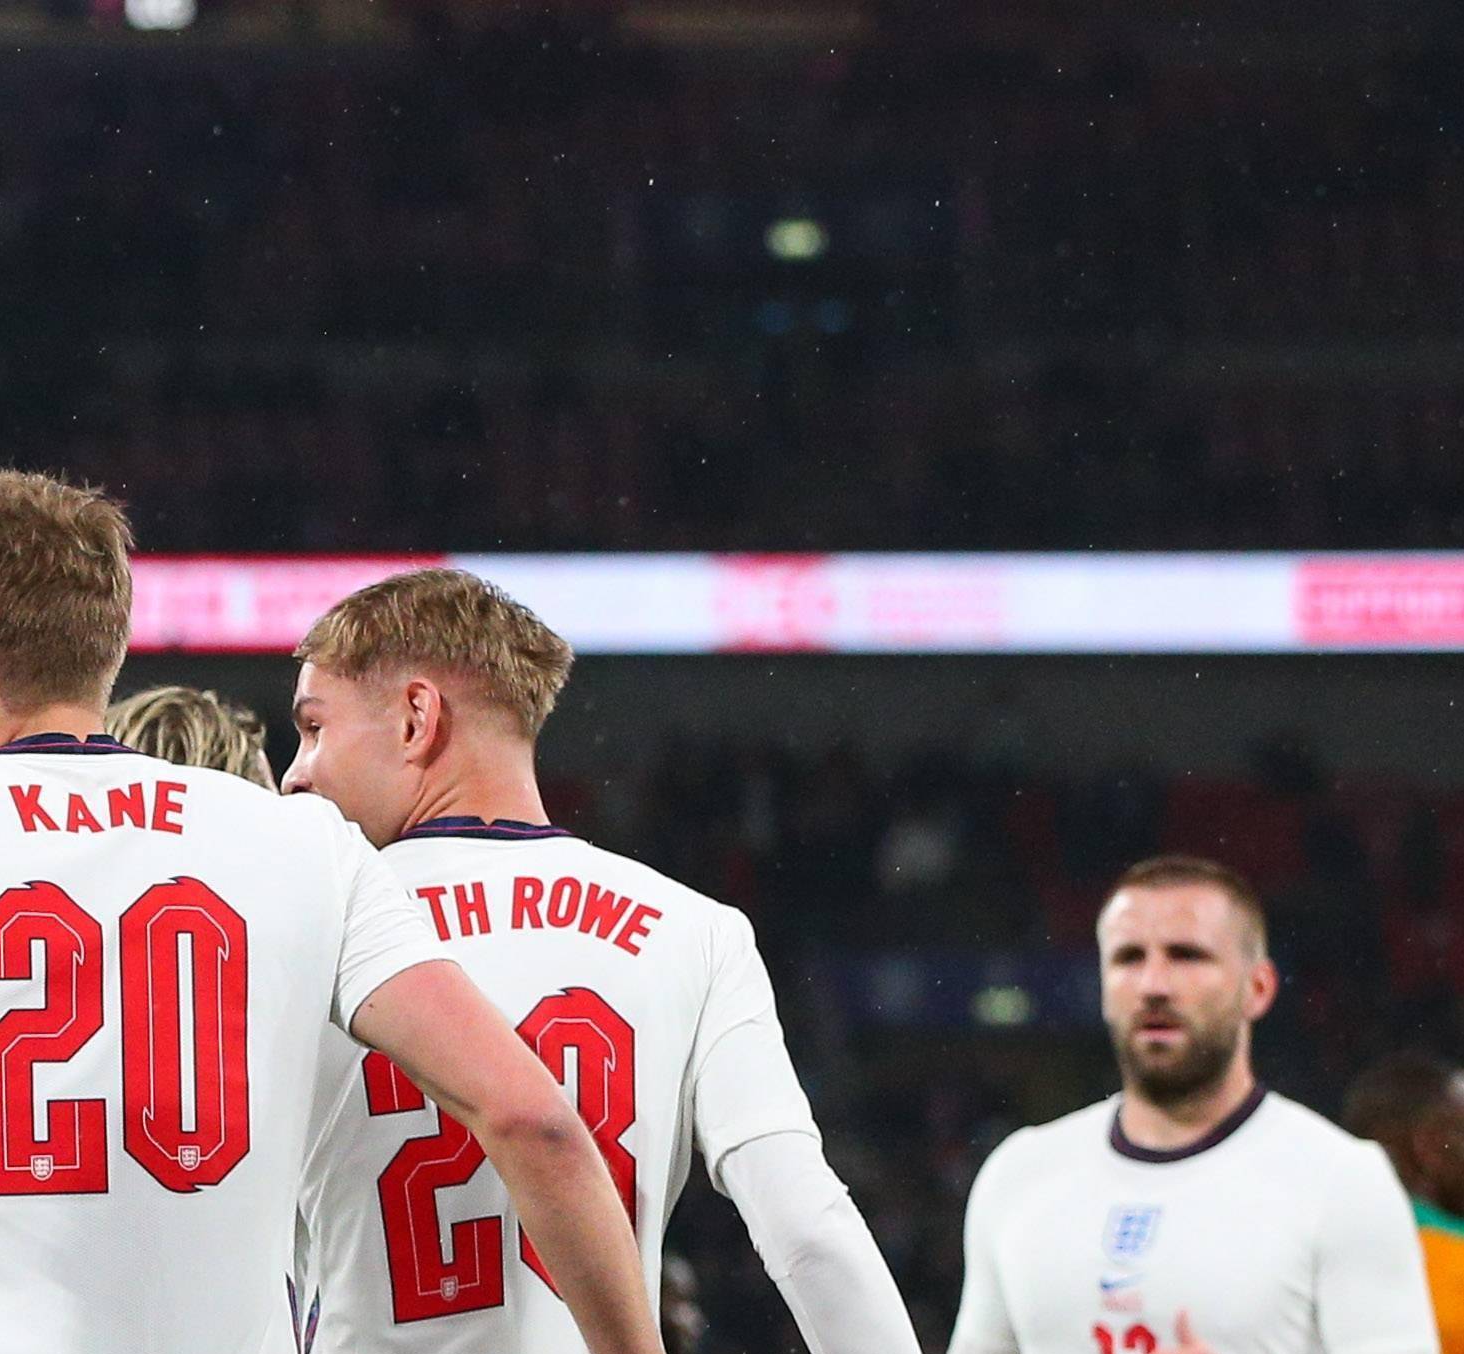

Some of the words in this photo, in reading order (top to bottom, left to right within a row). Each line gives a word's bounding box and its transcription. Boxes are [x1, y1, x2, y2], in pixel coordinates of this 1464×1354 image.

[8, 780, 188, 835] KANE
[414, 881, 493, 942] TH
[510, 875, 664, 956] ROWE
